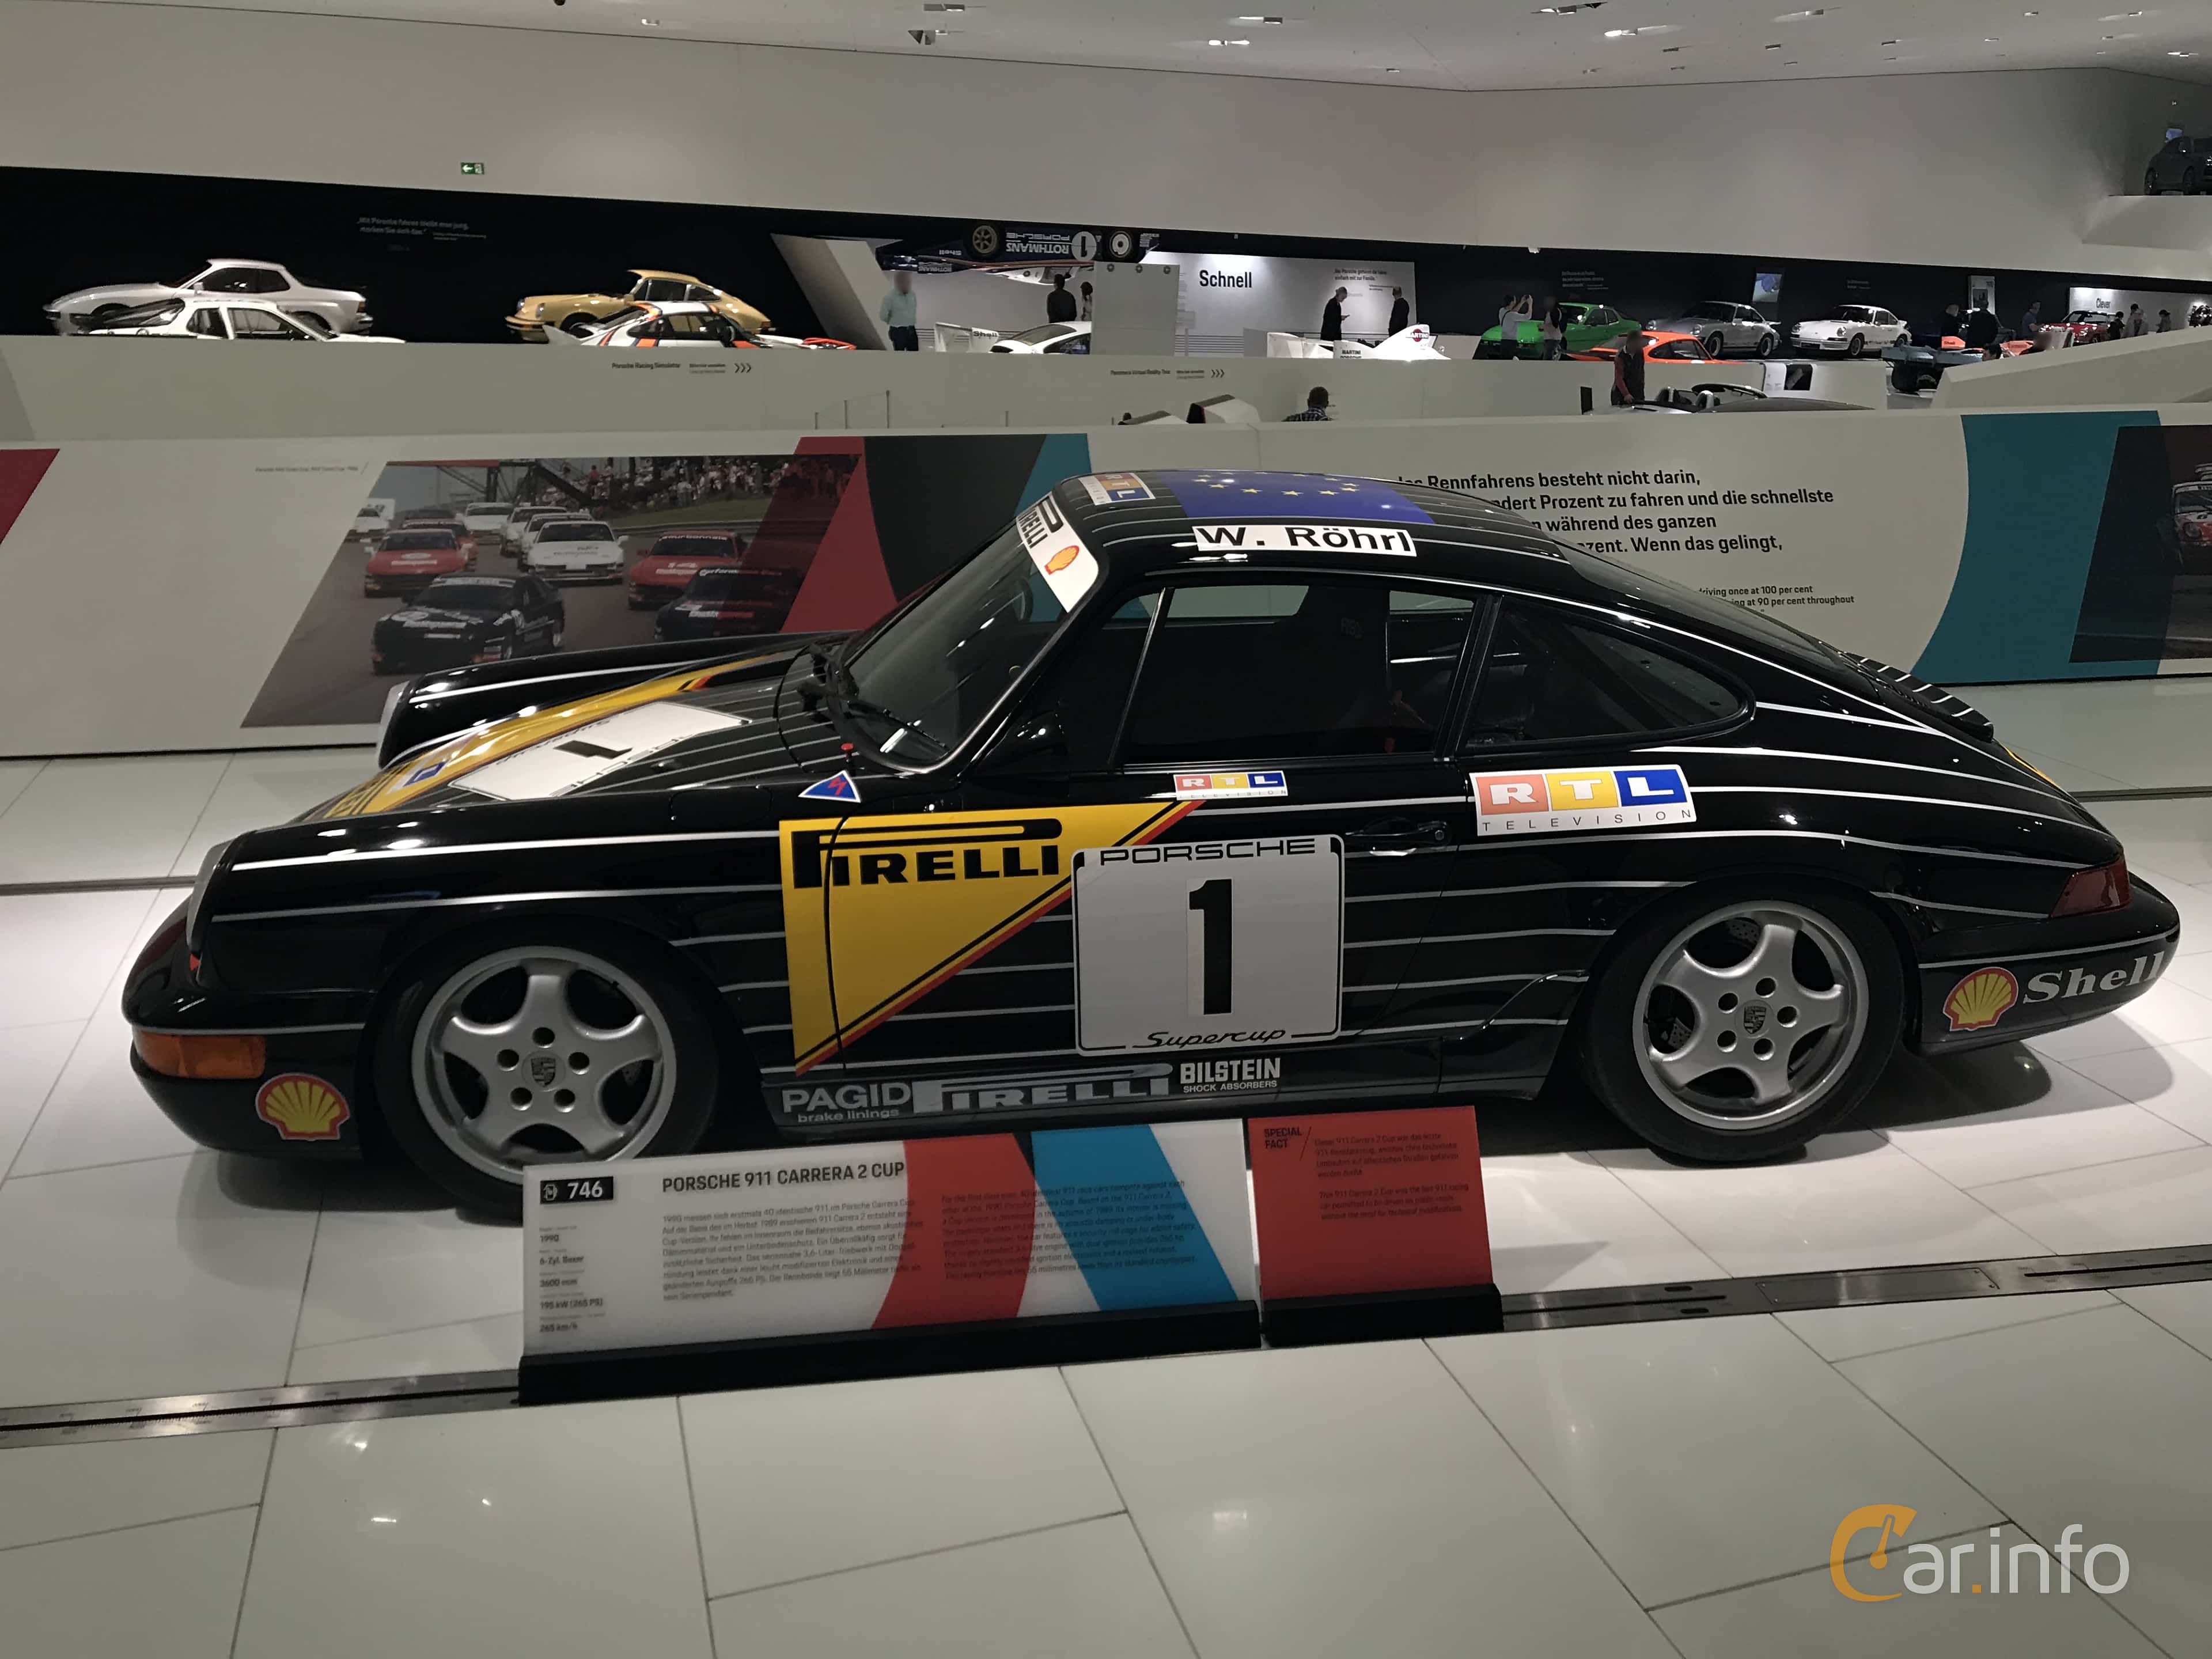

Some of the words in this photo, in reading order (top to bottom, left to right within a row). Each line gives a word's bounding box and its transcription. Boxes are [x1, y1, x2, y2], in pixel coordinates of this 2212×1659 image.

[1006, 232, 1070, 241] PORSCHE
[1006, 244, 1069, 254] ROTHMANS
[1199, 270, 1252, 288] Schnell
[2096, 297, 2111, 309] Clever
[1428, 473, 1535, 489] Rennfahrens
[1539, 471, 1603, 487] besteht
[1607, 471, 1649, 487] nicht
[1654, 469, 1700, 485] darin,
[1540, 494, 1604, 510] Prozent
[1608, 496, 1627, 508] zu
[1630, 492, 1684, 507] fahren
[1688, 490, 1718, 505] und
[1722, 490, 1747, 505] die
[1751, 488, 1834, 504] schnellste
[1546, 517, 1619, 531] während
[1623, 515, 1653, 529] des
[1657, 516, 1717, 532] ganzen
[1197, 527, 1266, 547] W.
[1285, 527, 1413, 552] Röhrl
[1630, 536, 1680, 552] Wenn
[1685, 536, 1714, 551] das
[1719, 535, 1782, 554] gelingt,
[1729, 588, 1749, 596] once
[1751, 587, 1759, 595] at
[1761, 586, 1777, 594] 100
[1779, 587, 1793, 596] per
[1794, 585, 1813, 594] cent
[1747, 598, 1756, 606] at
[1758, 597, 1769, 605] 90
[1771, 598, 1785, 607] per
[1786, 597, 1805, 605] cent
[1807, 596, 1854, 606] throughout
[1182, 775, 1278, 787] RTL
[1490, 777, 1675, 805] RTL
[1482, 809, 1691, 832] TELEVISION
[791, 818, 1062, 889] PIRELLI
[1100, 838, 1315, 866] PORSCHE
[1189, 878, 1232, 1016] 1
[2022, 950, 2165, 1004] Shell
[1133, 1028, 1286, 1049] Supercup
[1180, 1058, 1281, 1085] BILSTEIN
[913, 1063, 1173, 1113] PIRELLI
[1183, 1082, 1217, 1094] SHOCK
[1219, 1080, 1277, 1092] ABSORBERS
[782, 1080, 911, 1114] PAGID
[797, 1110, 843, 1124] brake
[846, 1107, 899, 1122] linings
[1264, 1127, 1302, 1138] SPECIAL
[1265, 1138, 1289, 1149] FACT
[662, 1173, 740, 1192] PORSCHE
[745, 1172, 771, 1187] 911
[778, 1165, 854, 1184] CARRERA
[858, 1164, 868, 1179] 2
[871, 1162, 904, 1178] CUP
[567, 1180, 603, 1199] 746
[815, 1204, 828, 1213] 911
[842, 1202, 870, 1211] Porsche
[872, 1200, 897, 1209] Carrera
[819, 1215, 831, 1223] 911
[834, 1214, 859, 1222] Carrera
[540, 1234, 559, 1243] 1990
